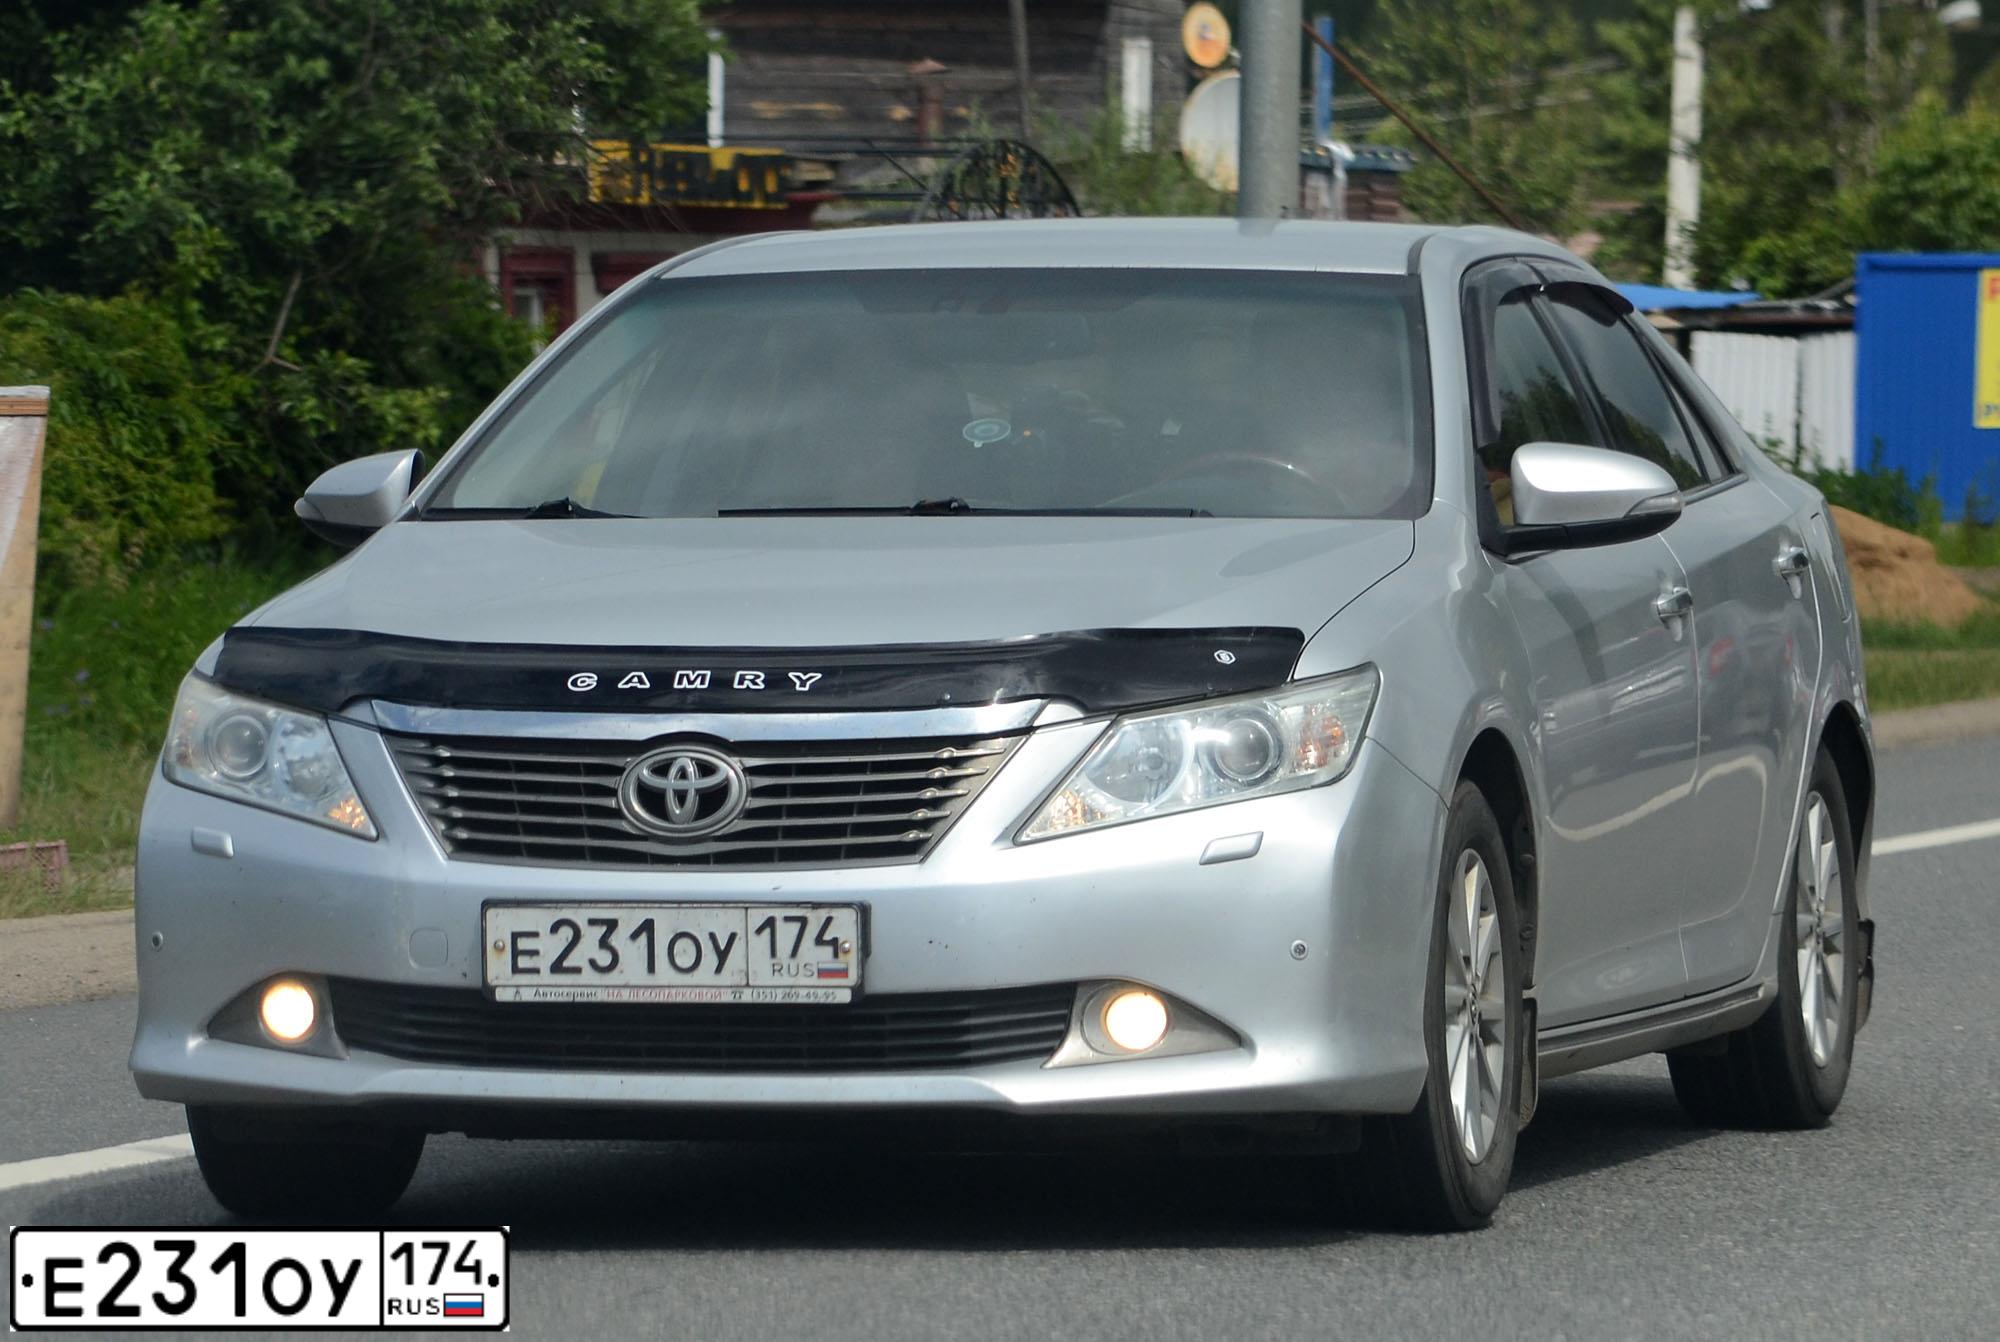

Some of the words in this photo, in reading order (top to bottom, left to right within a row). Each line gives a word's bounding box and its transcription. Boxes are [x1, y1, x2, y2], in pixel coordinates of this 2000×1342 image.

[567, 670, 822, 692] CAMRY
[510, 918, 738, 975] E231OY
[754, 915, 840, 960] 174
[771, 962, 815, 978] RUS
[533, 986, 598, 1003] Автосервис
